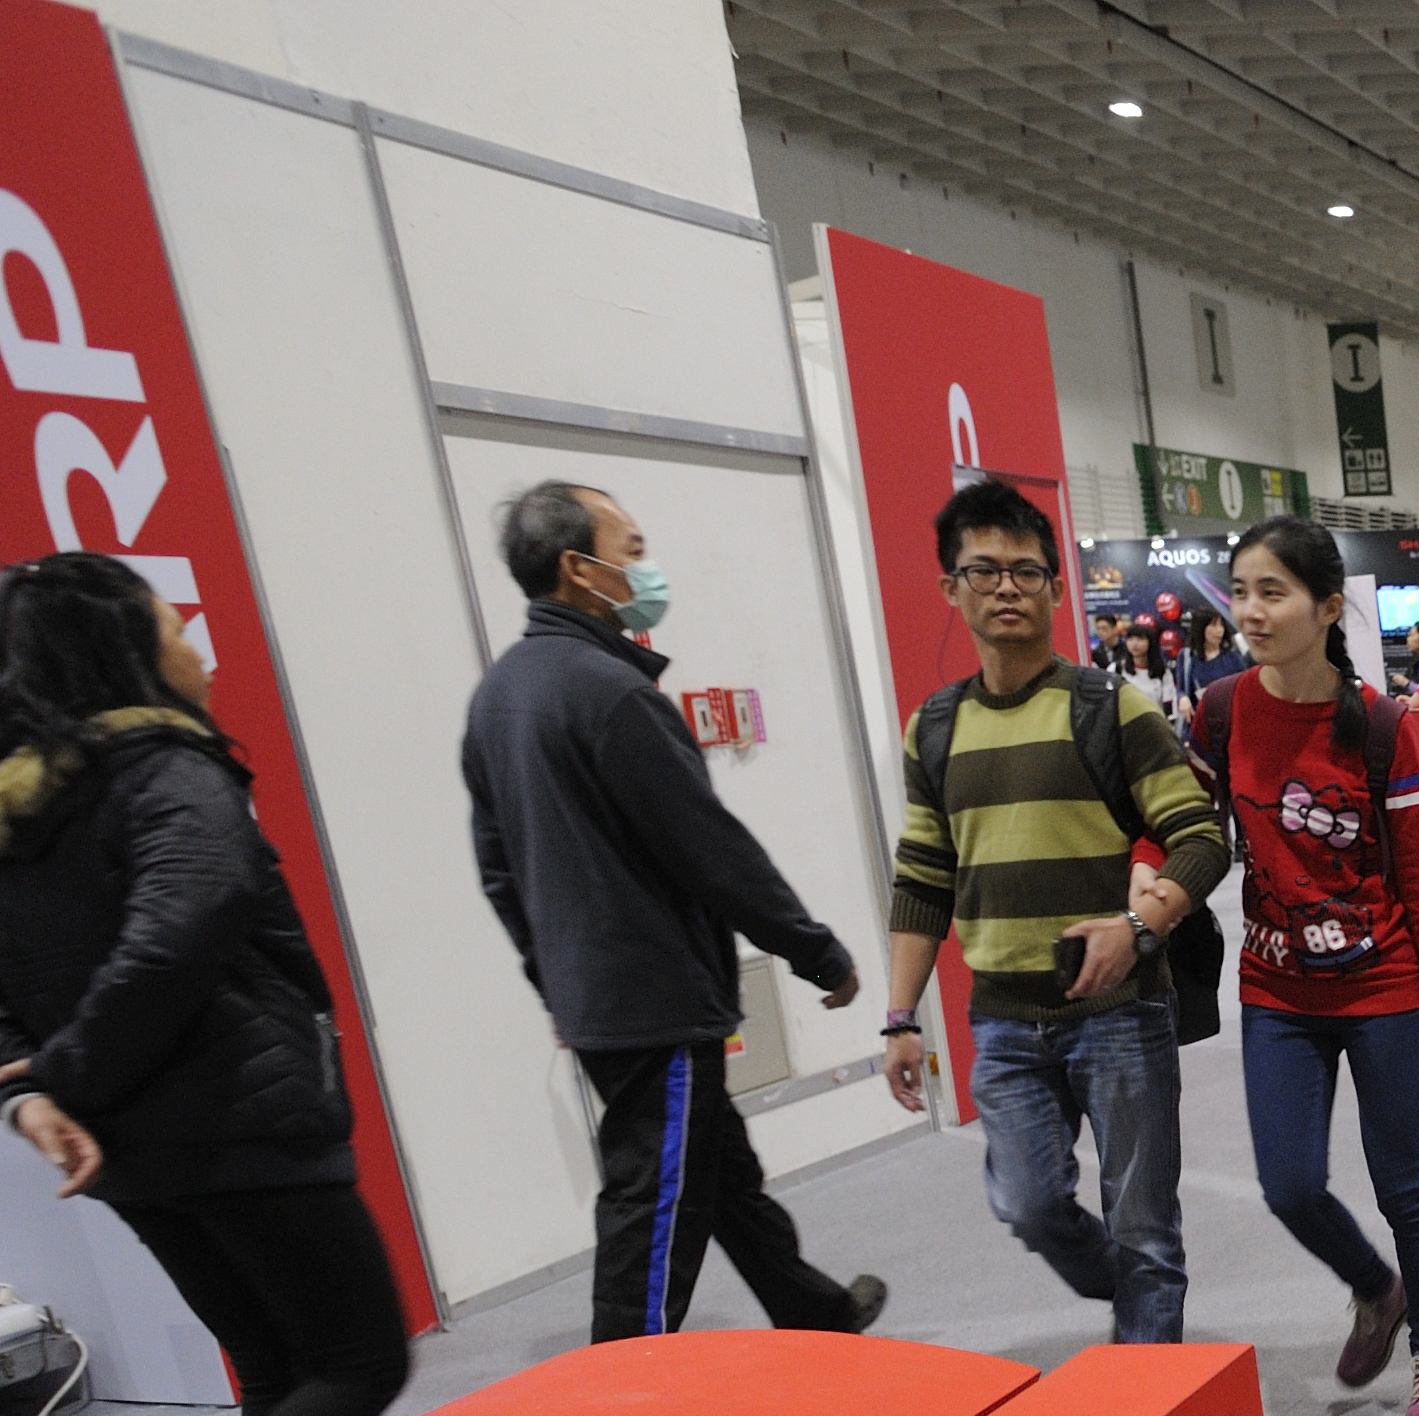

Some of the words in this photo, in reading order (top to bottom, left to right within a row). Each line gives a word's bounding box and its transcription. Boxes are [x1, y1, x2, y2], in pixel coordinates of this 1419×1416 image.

[1181, 454, 1208, 480] EXIT
[1146, 548, 1211, 569] AQUOS
[1303, 919, 1347, 954] 86
